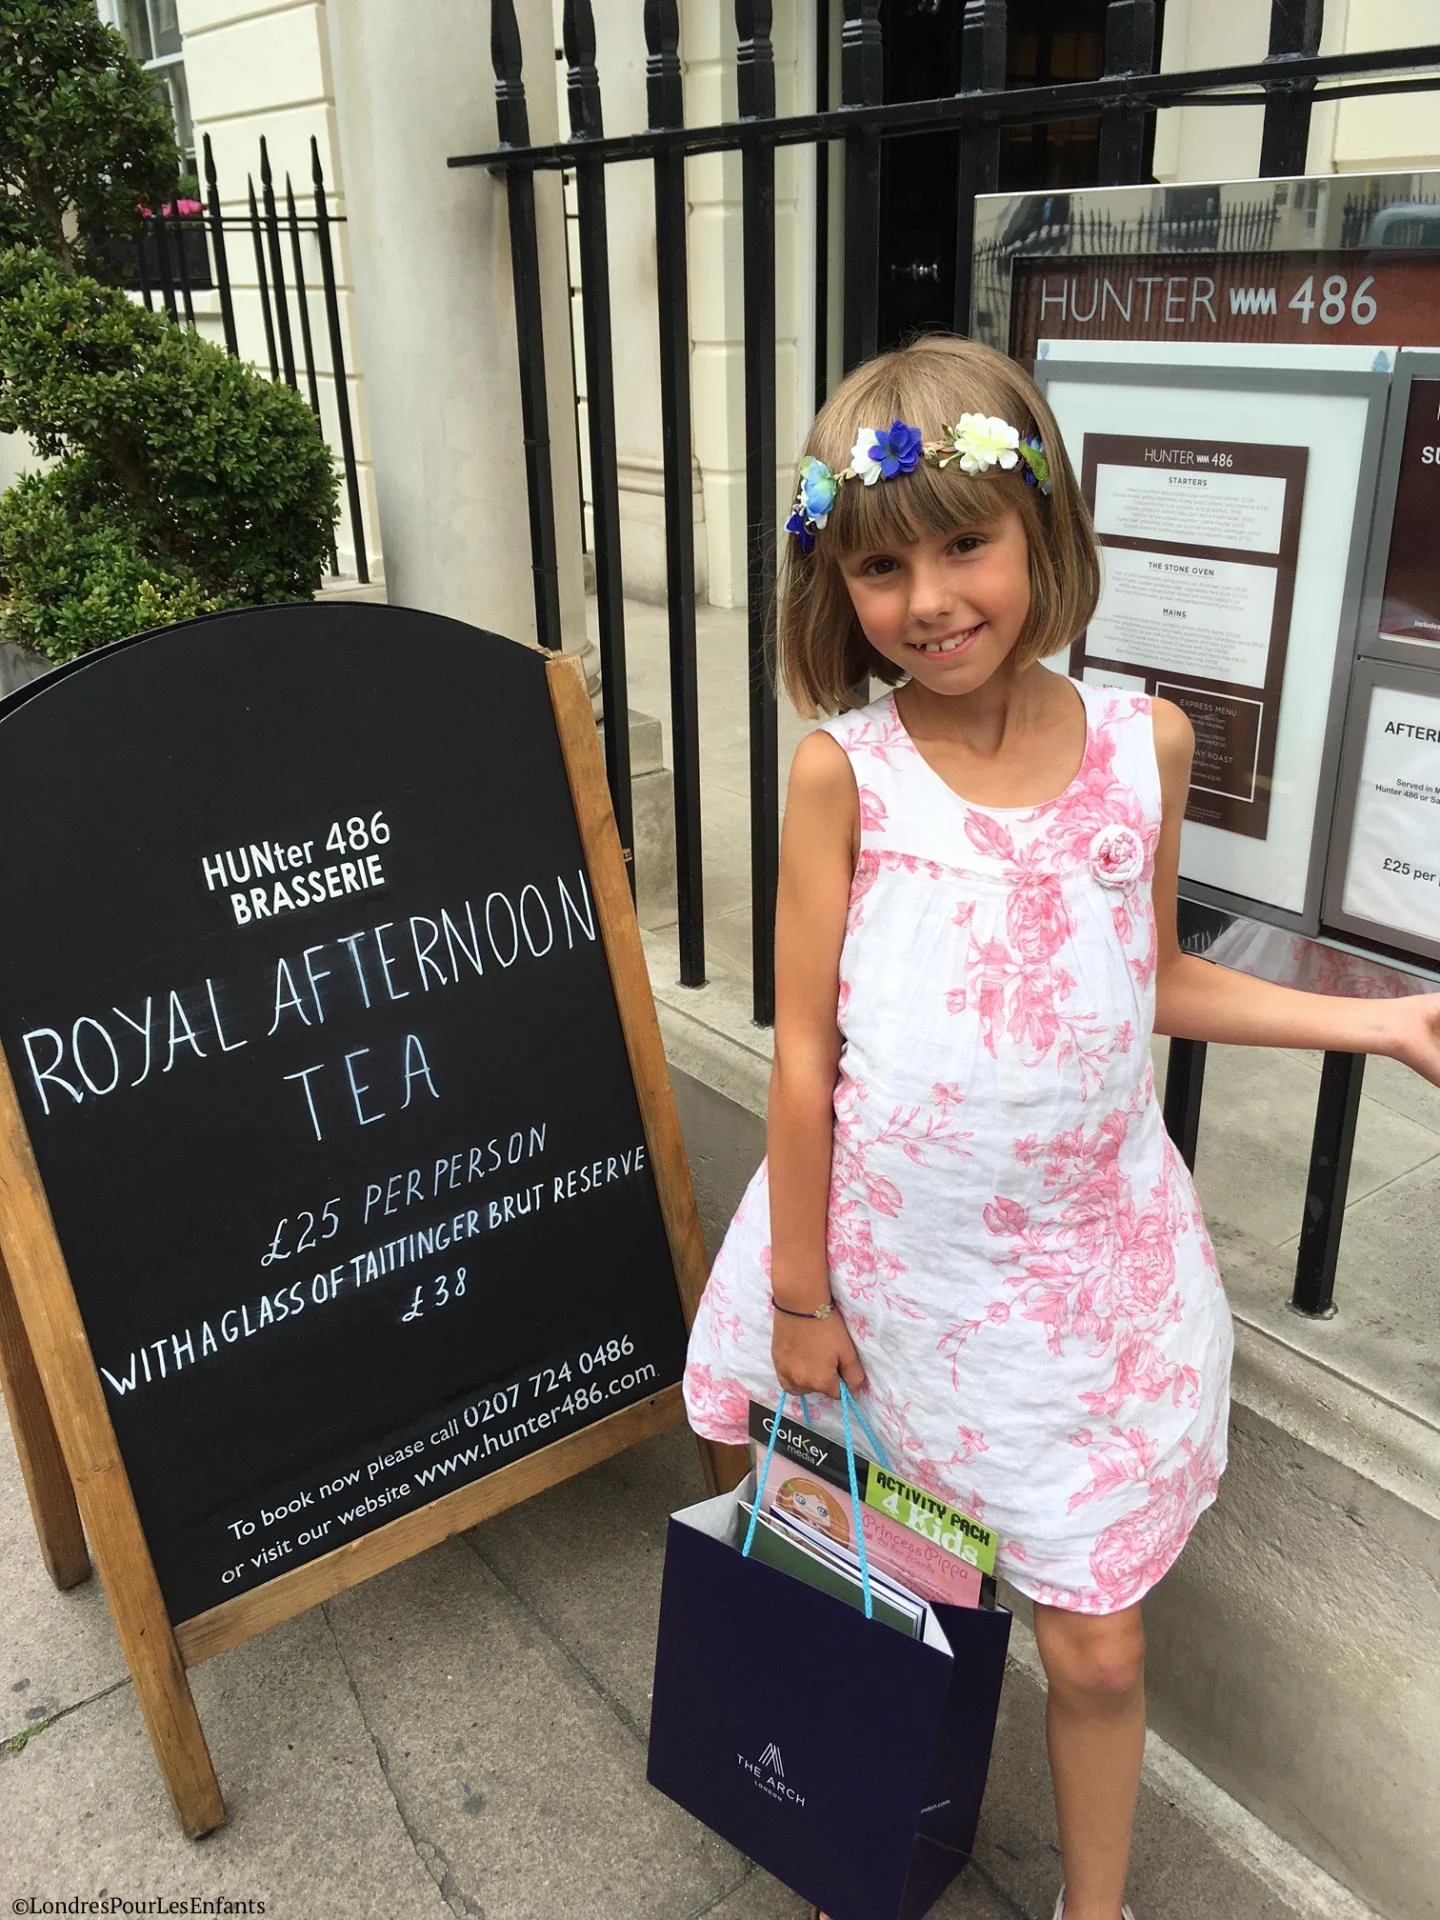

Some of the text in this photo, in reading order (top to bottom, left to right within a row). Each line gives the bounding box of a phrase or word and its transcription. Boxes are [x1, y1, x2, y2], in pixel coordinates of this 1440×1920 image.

[1040, 275, 1377, 325] HUNTER 486
[1144, 448, 1233, 467] HUNTER 486
[1168, 476, 1208, 487] STARTERS
[1148, 561, 1215, 577] THE STONE OVEN
[1162, 608, 1187, 618] MAINS
[1180, 698, 1237, 717] EXPRESS MENU
[1208, 752, 1232, 763] ROAST
[1375, 783, 1402, 796] Hunter
[1403, 791, 1418, 800] 486
[1396, 778, 1424, 791] Served
[202, 811, 391, 891] HUNter 486
[1383, 857, 1410, 876] £25
[1413, 868, 1437, 884] per
[231, 854, 385, 925] BRASSERIE
[22, 869, 597, 1116] ROYAL AFTERNOON
[283, 1033, 440, 1141] TEA
[261, 1123, 547, 1267] £25 PER PERSON
[100, 1329, 195, 1396] WITH
[221, 1282, 306, 1343] GLASS
[312, 1265, 344, 1304] OF
[349, 1208, 480, 1288] TAITTINGER
[488, 1184, 544, 1229] BRUT
[552, 1145, 645, 1203] RESERVE
[227, 1334, 635, 1541] To book now please call 0207 724 0486
[787, 1444, 815, 1464] media
[221, 1563, 245, 1584] or
[250, 1539, 293, 1568] visit
[297, 1519, 332, 1546] our
[338, 1481, 411, 1526] website
[877, 1471, 991, 1546] ACTIVITY PACK
[881, 1493, 978, 1567] 4 Kids
[862, 1514, 921, 1557] Princess
[925, 1544, 968, 1580] Pippa
[736, 1753, 805, 1808] THE ARCH
[753, 1780, 783, 1802] LONDON
